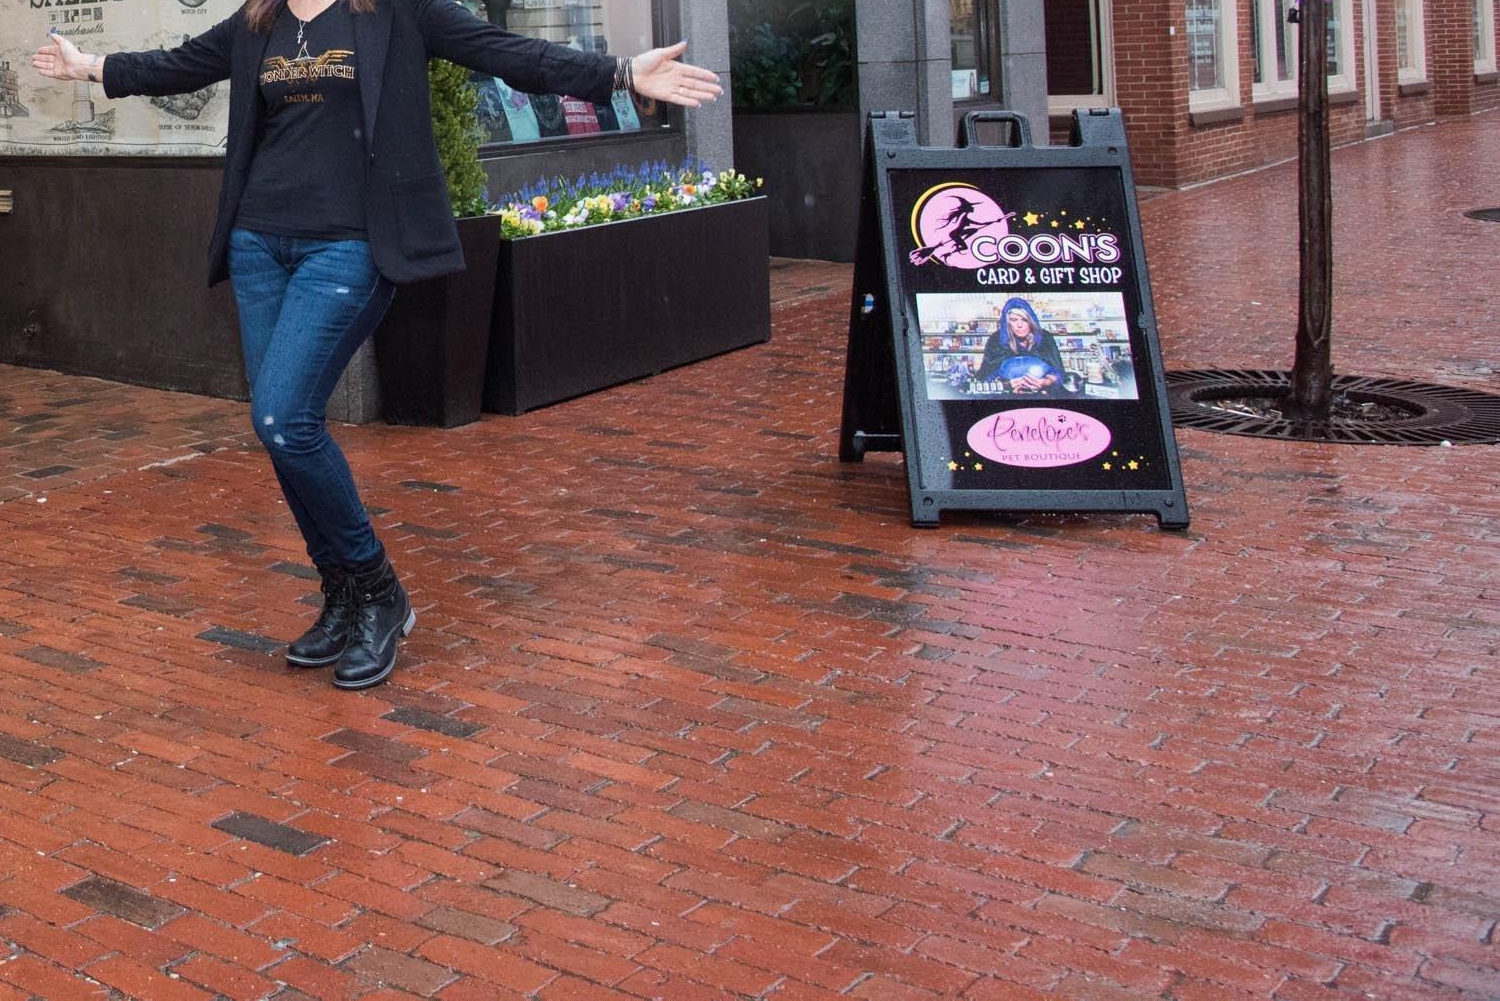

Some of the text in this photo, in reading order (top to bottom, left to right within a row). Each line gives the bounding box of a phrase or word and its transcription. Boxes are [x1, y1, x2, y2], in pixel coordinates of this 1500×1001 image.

[308, 64, 355, 79] WITCH
[971, 233, 1120, 264] COON'S
[977, 267, 1122, 284] CARD & GIFT SHOP
[987, 415, 1089, 452] Penelope's
[1024, 453, 1081, 461] BOUTIQUE
